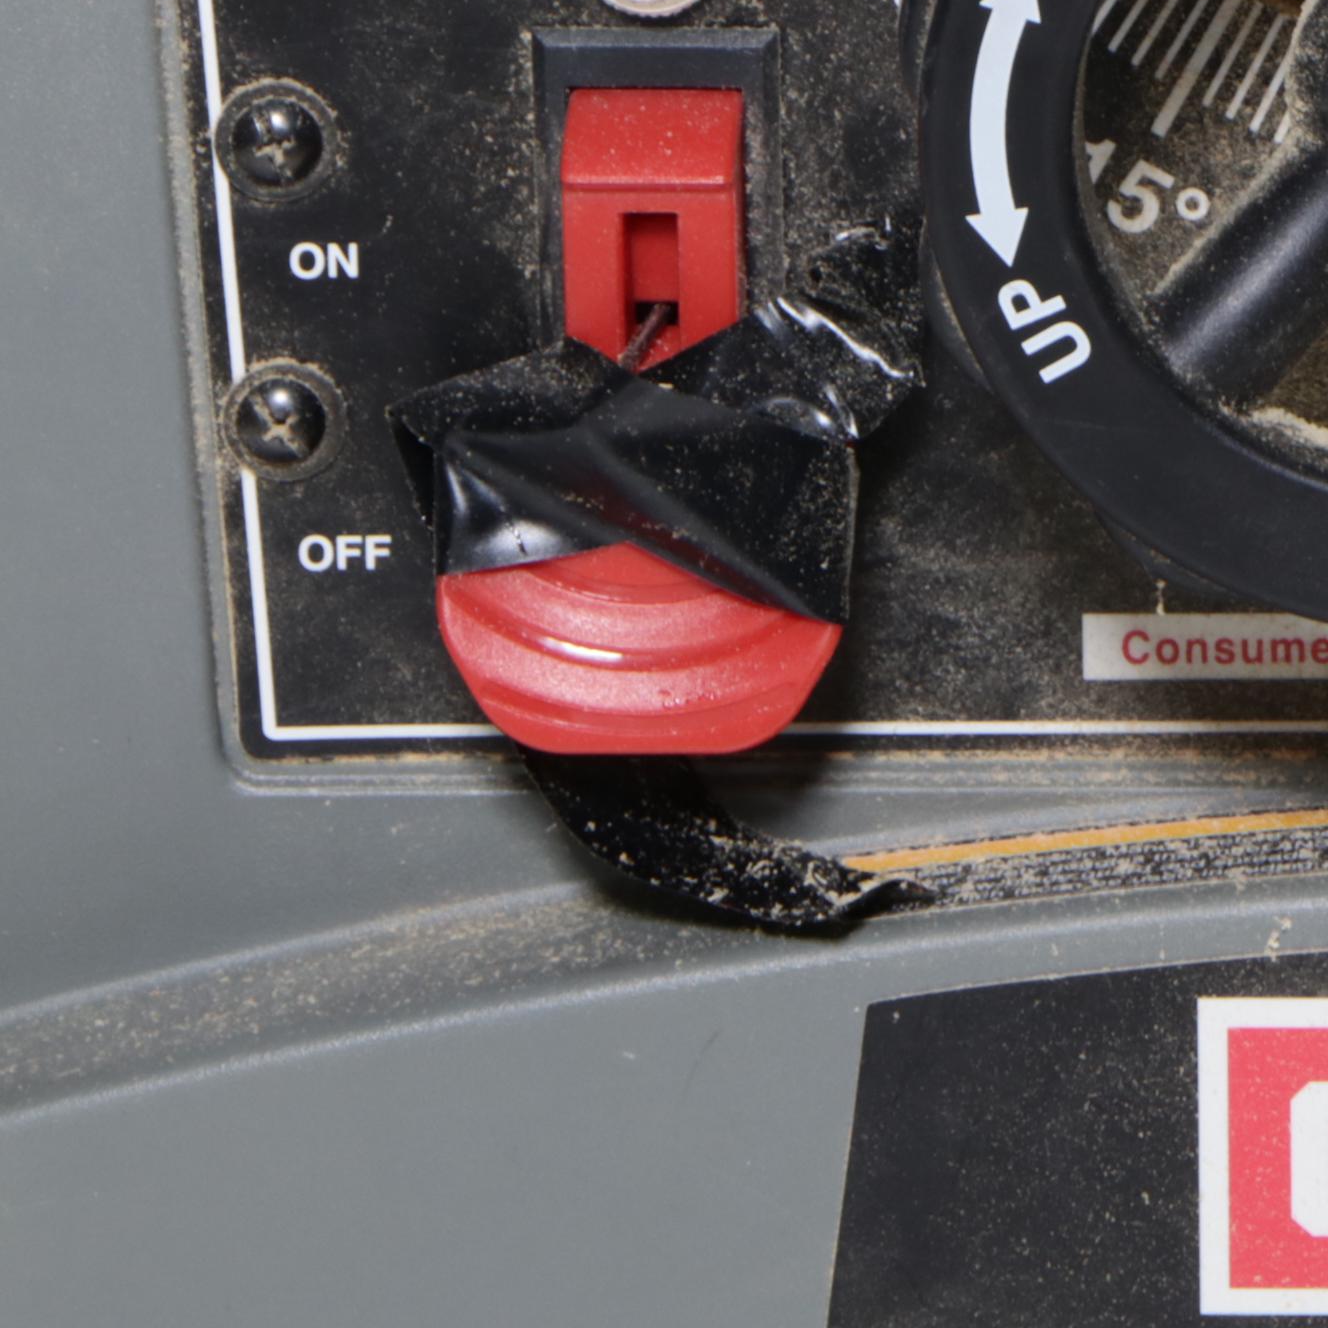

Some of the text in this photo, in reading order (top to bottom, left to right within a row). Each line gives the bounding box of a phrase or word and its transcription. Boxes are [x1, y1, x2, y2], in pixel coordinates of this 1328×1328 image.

[290, 243, 358, 279] ON
[997, 279, 1092, 384] UP
[299, 535, 391, 571] OFF
